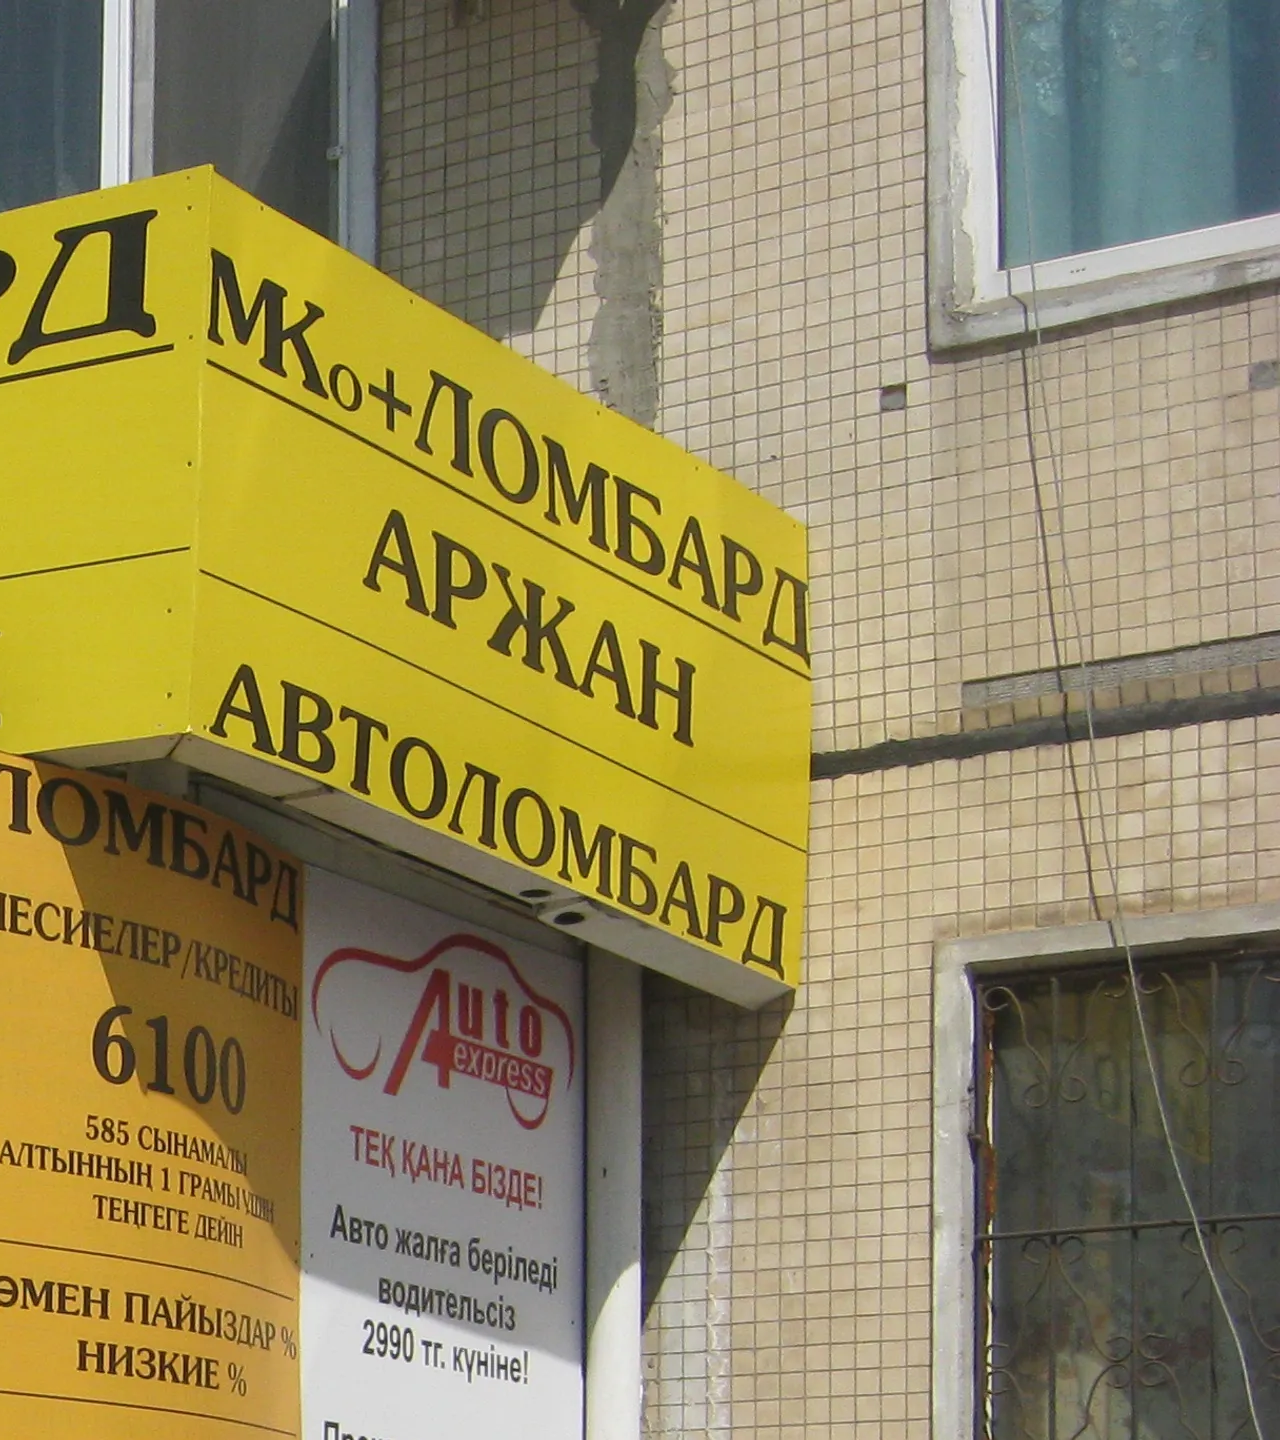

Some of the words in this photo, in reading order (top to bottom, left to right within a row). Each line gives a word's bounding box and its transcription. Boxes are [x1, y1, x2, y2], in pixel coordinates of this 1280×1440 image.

[363, 509, 697, 747] АРЖАН
[209, 664, 787, 981] АВТОЛОМБАРД
[92, 1006, 246, 1116] 6100
[383, 968, 541, 1096] Auto
[452, 1039, 548, 1096] express
[86, 1114, 130, 1146] 585
[137, 1125, 248, 1176] СЫНАМАЛЫ
[161, 1167, 171, 1192] 1
[179, 1171, 240, 1210] ГРАМЫ
[471, 1158, 542, 1211] БІЗДЕ!
[330, 1204, 388, 1250] Авто
[395, 1228, 461, 1267] жалға
[468, 1238, 558, 1294] беріледі
[123, 1291, 276, 1350] ПАЙЫЗДАР
[281, 1326, 297, 1360] %
[378, 1277, 516, 1331] водительсіз
[76, 1339, 220, 1390] НИЗКИЕ
[228, 1362, 247, 1397] %
[362, 1319, 415, 1363] 2990
[421, 1339, 445, 1369] тг.
[452, 1345, 529, 1384] күніне!
